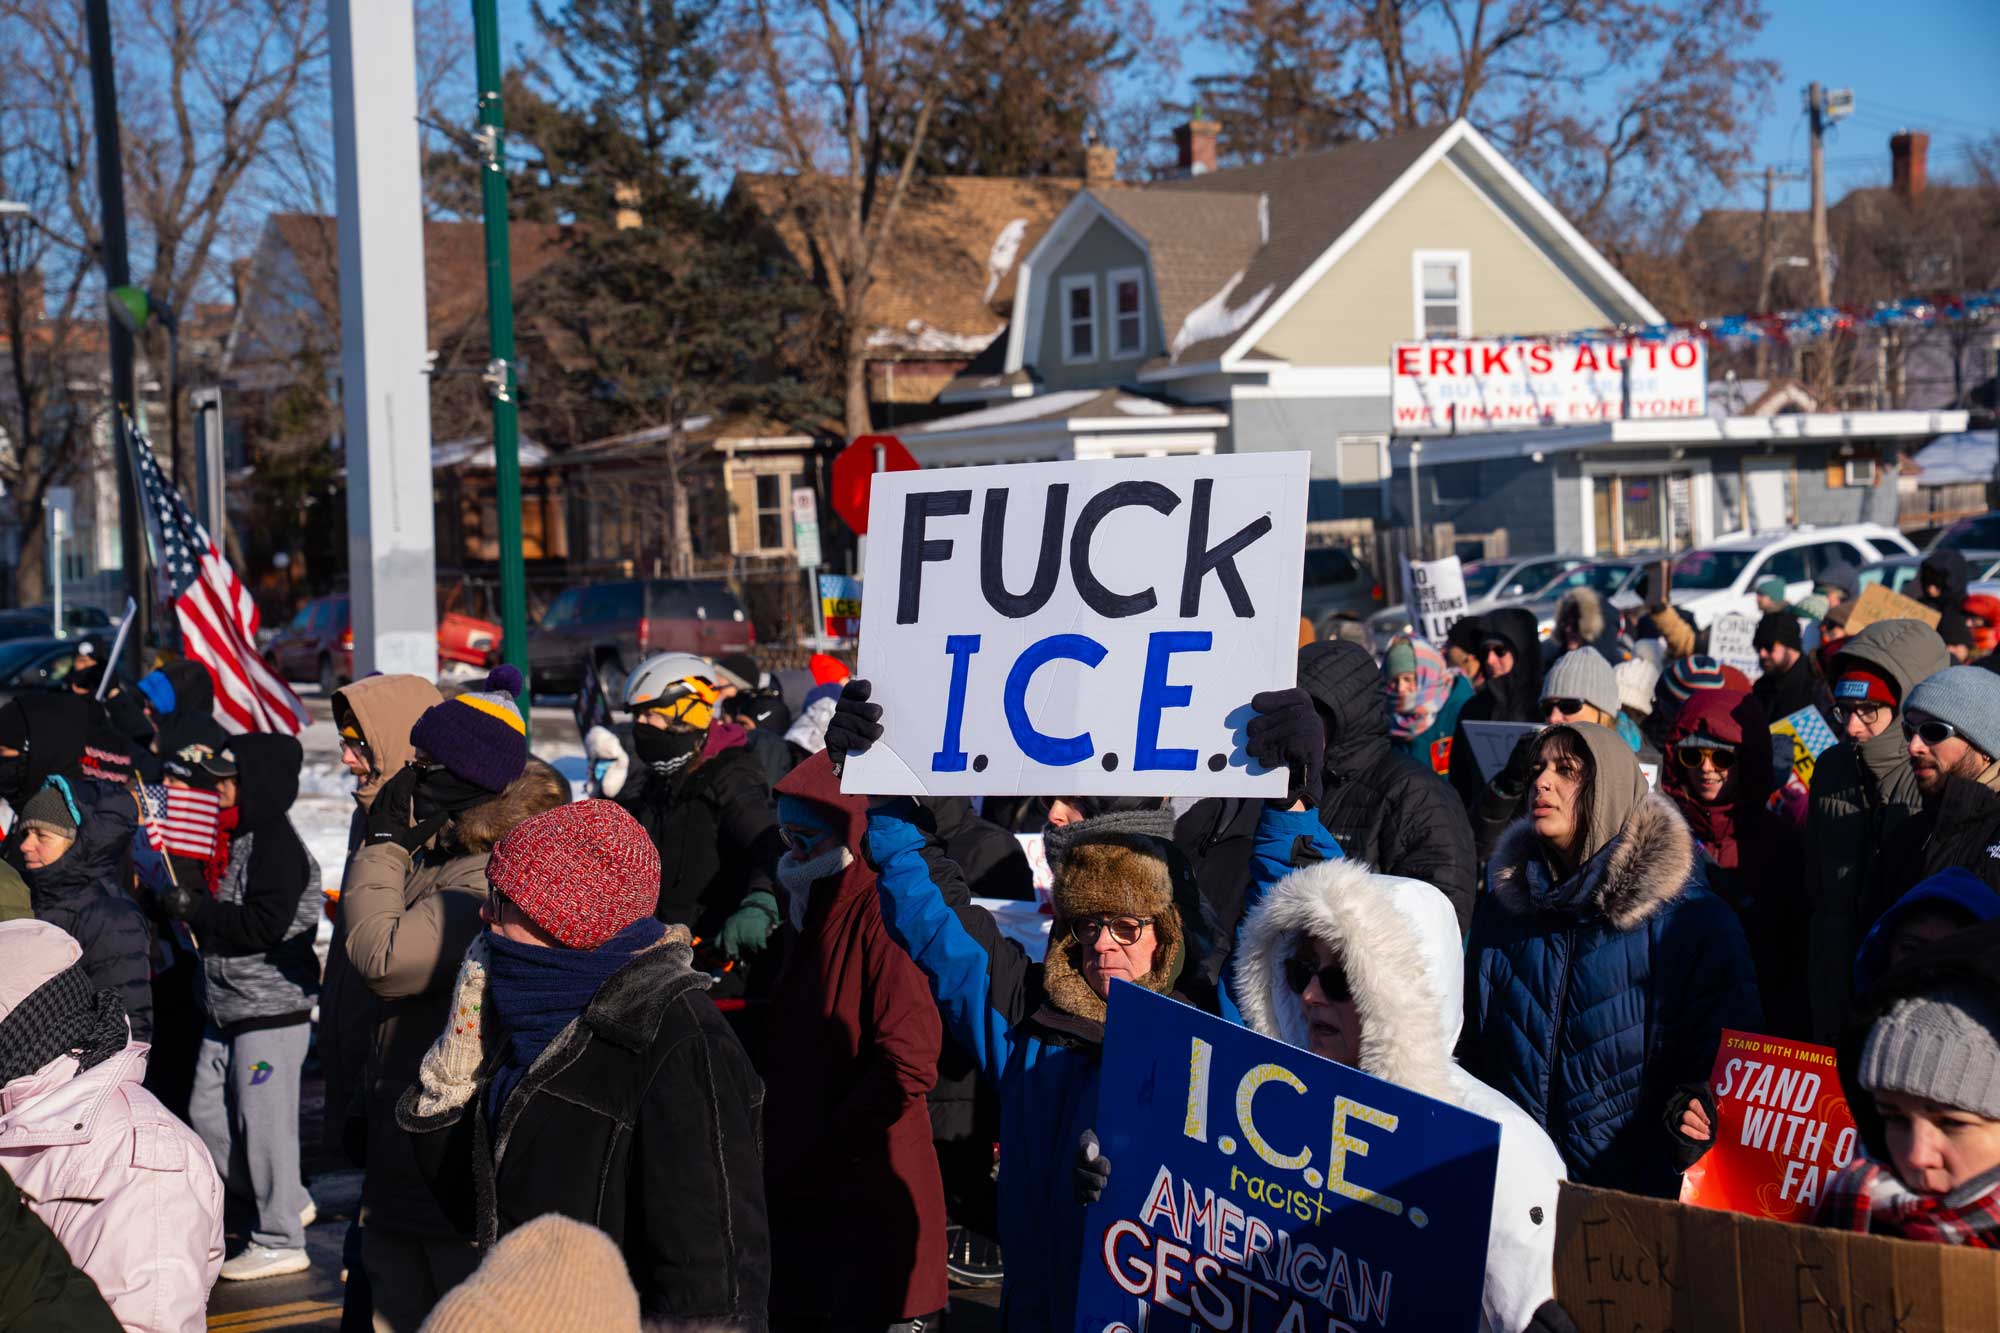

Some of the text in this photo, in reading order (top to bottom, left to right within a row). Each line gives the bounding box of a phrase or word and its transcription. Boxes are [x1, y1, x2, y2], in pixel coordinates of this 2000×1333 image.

[1397, 340, 1698, 376] ERIK'S AUTO
[1397, 405, 1430, 422] WE
[931, 631, 1228, 772] I.C.E.
[1727, 1037, 1760, 1052] STAND
[1763, 1043, 1792, 1058] WITH
[1716, 1058, 1821, 1114] STAND
[1741, 1106, 1828, 1162] WITH
[1230, 1166, 1331, 1226] racist
[1780, 1160, 1837, 1206] FA
[1140, 1165, 1393, 1326] AMERICAN
[1582, 1217, 1683, 1291] Fuck
